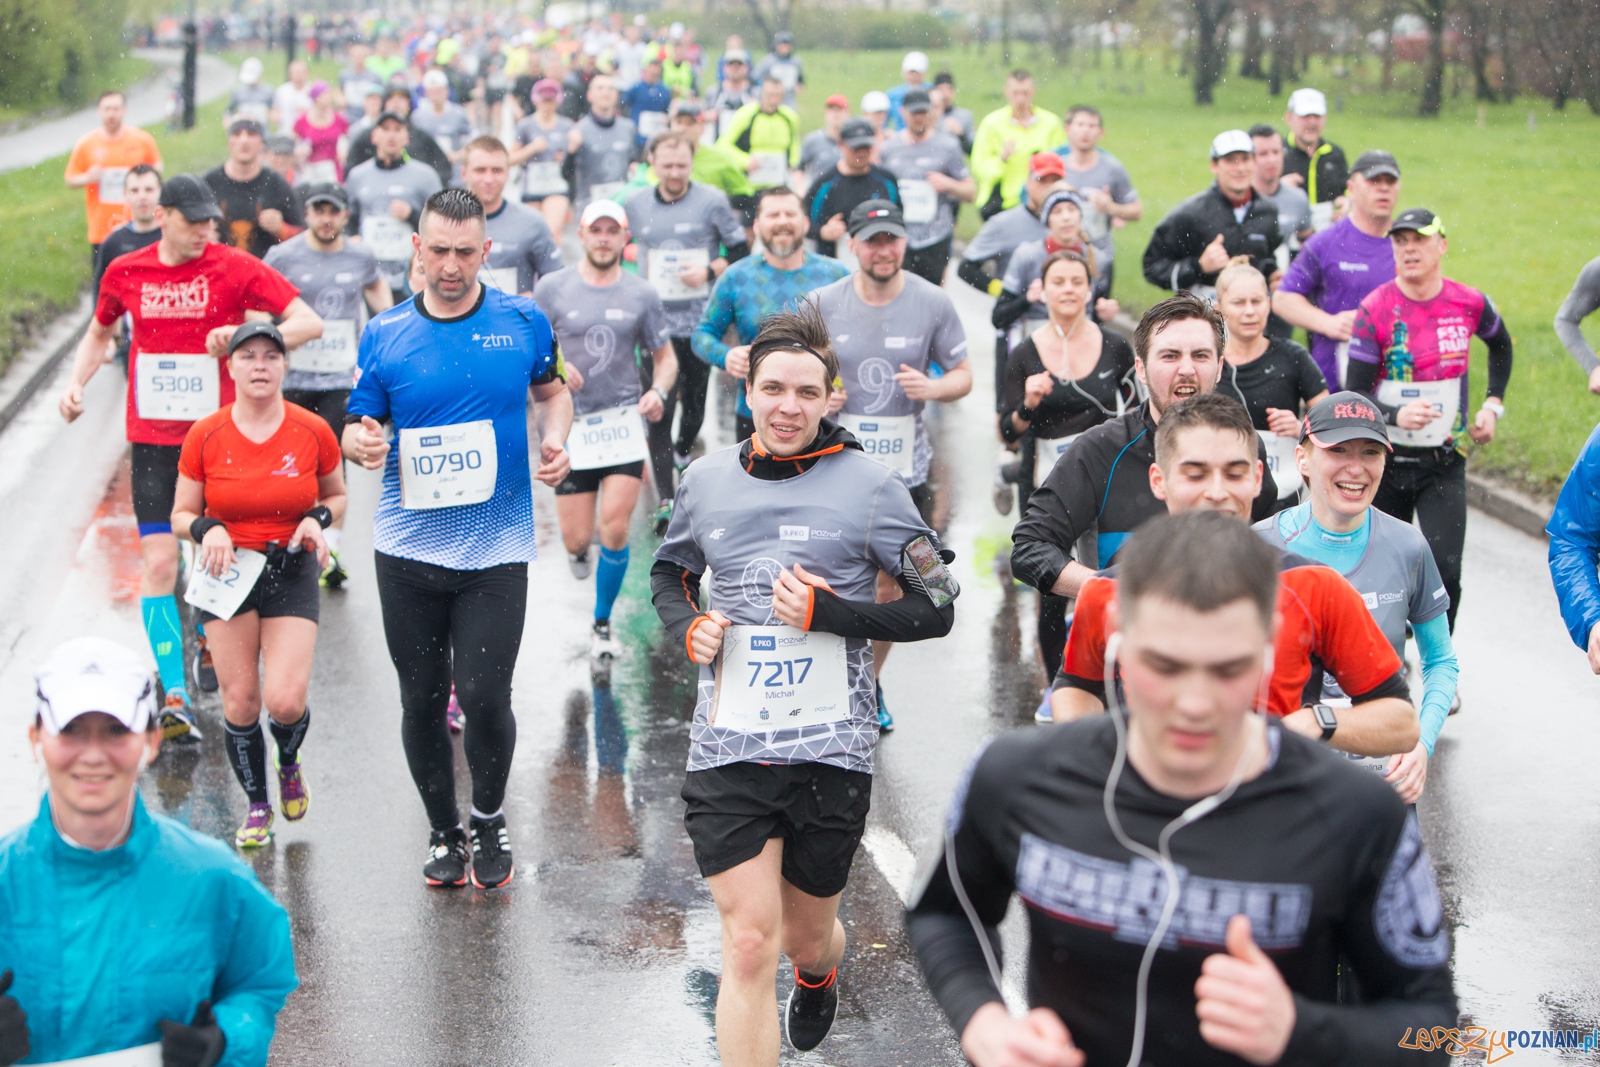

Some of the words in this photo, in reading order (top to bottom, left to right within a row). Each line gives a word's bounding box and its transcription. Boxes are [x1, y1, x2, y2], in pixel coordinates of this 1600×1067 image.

[140, 290, 209, 310] SZPIKU
[152, 376, 203, 393] 5308
[1334, 402, 1376, 422] RUN
[582, 425, 630, 446] 10610
[411, 450, 482, 476] 10790
[709, 528, 726, 540] 4F
[753, 639, 772, 647] 9.PKO
[747, 657, 813, 687] 7217
[765, 689, 795, 699] Michał
[233, 736, 257, 792] Kalenji
[1361, 763, 1383, 771] olina
